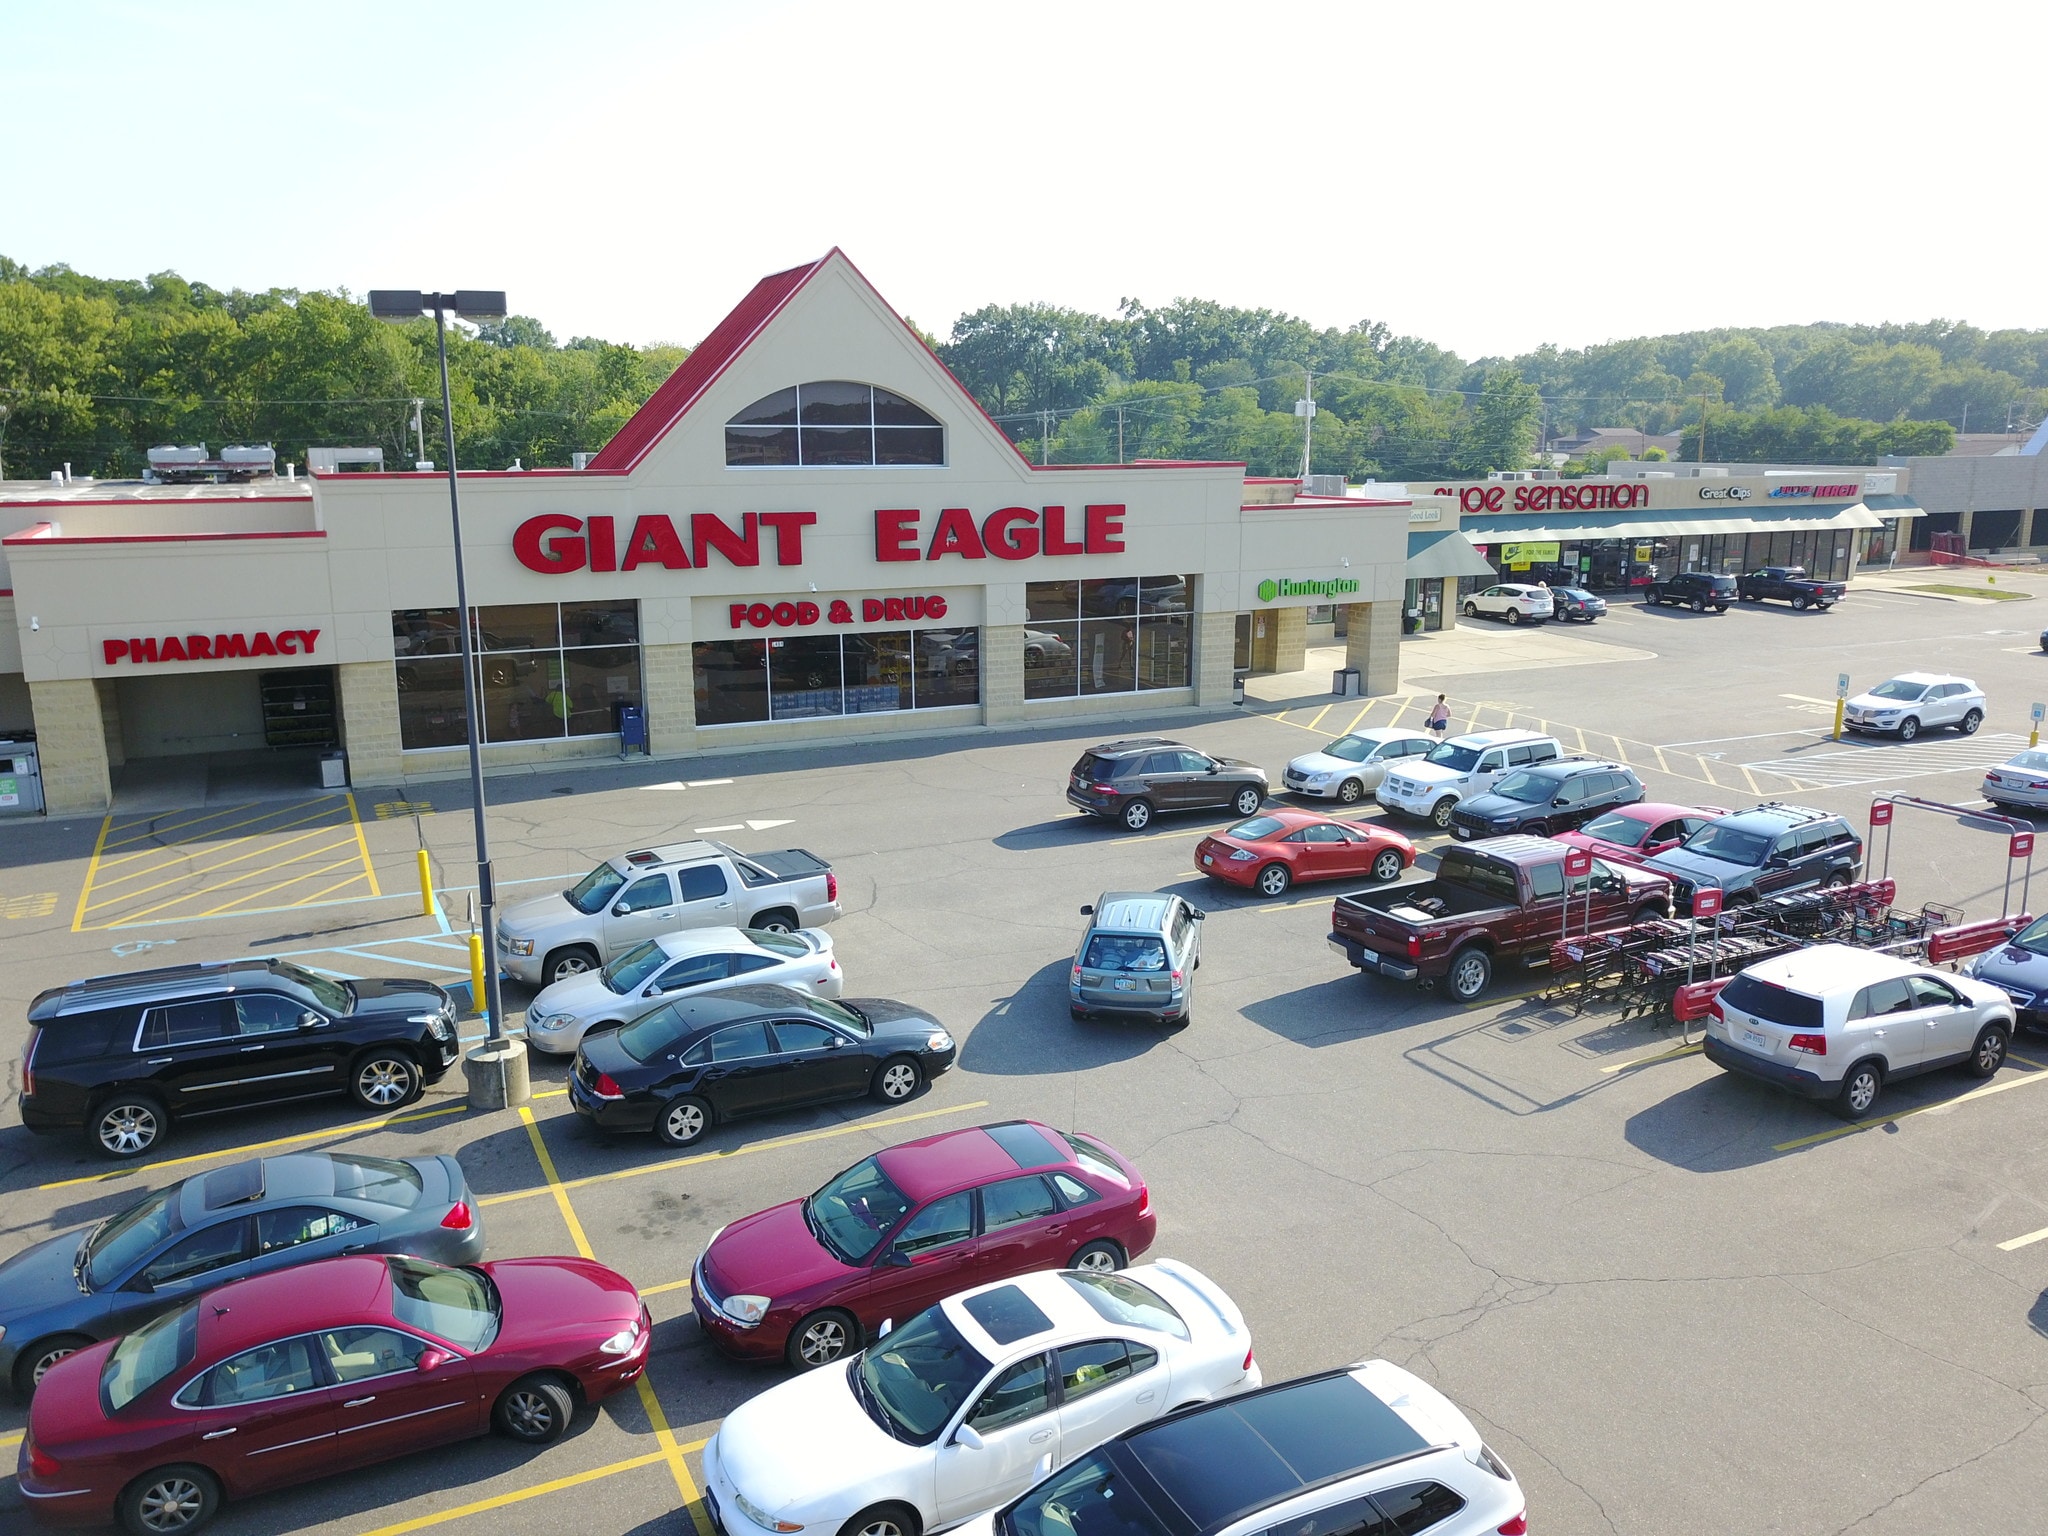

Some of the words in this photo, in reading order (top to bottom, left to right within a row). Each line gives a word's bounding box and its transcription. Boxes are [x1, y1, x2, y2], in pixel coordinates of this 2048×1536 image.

[1434, 486, 1506, 513] oe
[1699, 487, 1728, 499] Great
[1729, 487, 1751, 501] Clips
[1814, 484, 1859, 498] BEACH
[512, 511, 817, 575] GIANT
[874, 503, 1126, 562] EAGLE
[1279, 577, 1360, 599] Huntington
[729, 601, 820, 629] FOOD
[827, 599, 855, 625] &
[863, 595, 948, 623] DRUG
[103, 628, 321, 665] PHARMACY
